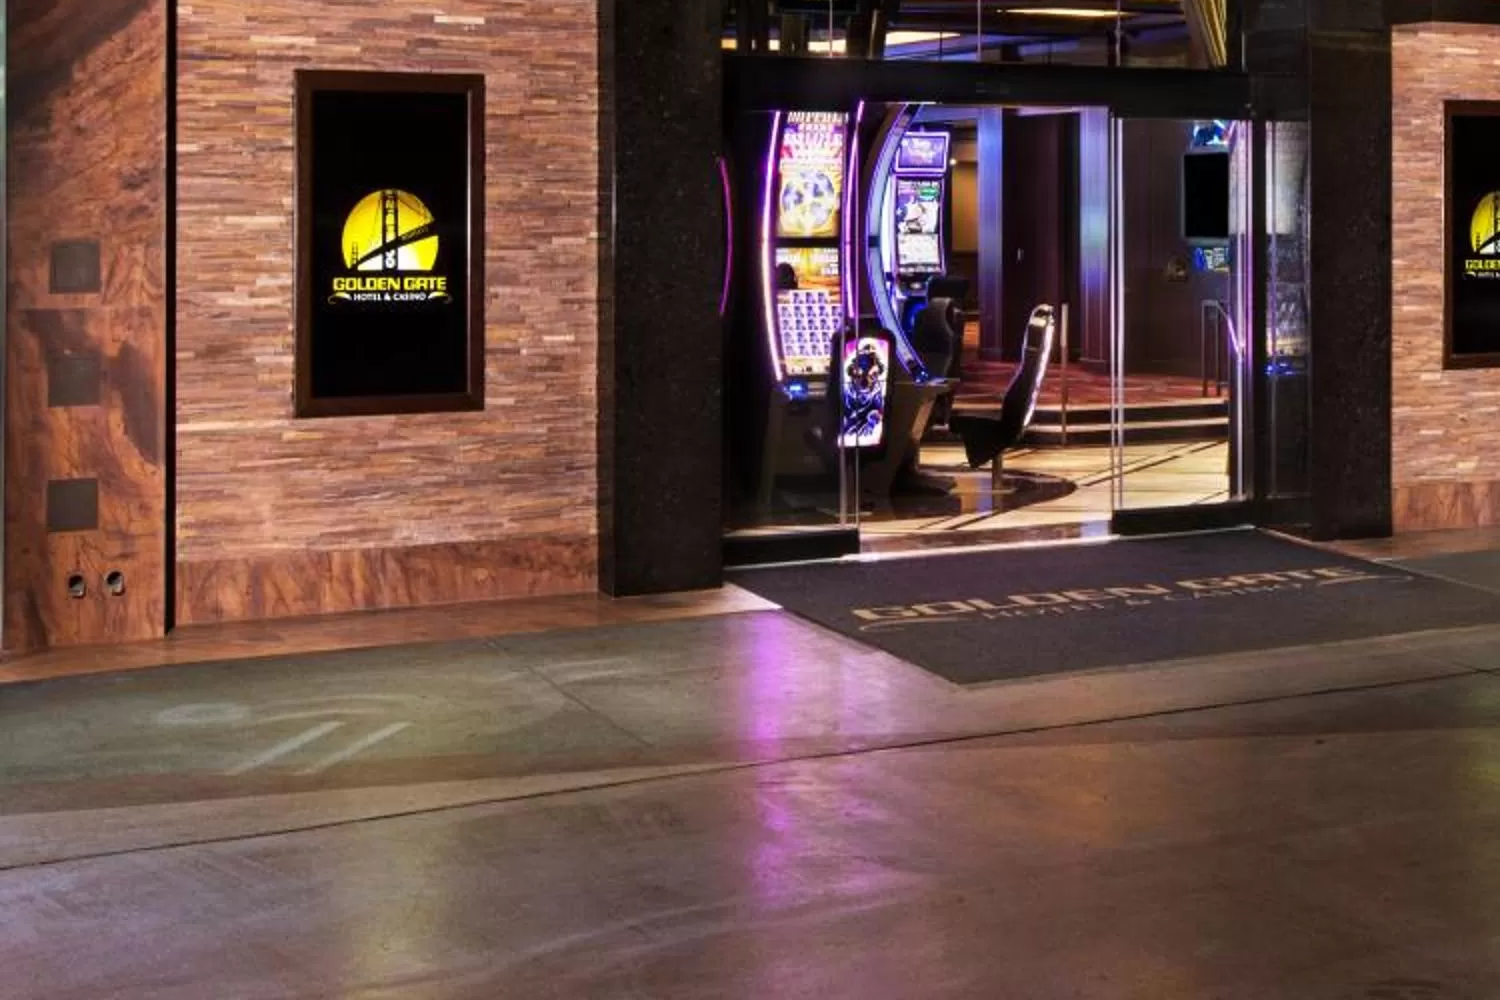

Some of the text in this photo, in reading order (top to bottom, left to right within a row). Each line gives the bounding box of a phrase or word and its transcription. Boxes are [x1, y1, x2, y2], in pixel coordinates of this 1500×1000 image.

[333, 277, 447, 290] GOLDEN GATE
[852, 565, 1367, 621] GOLDEN GATE
